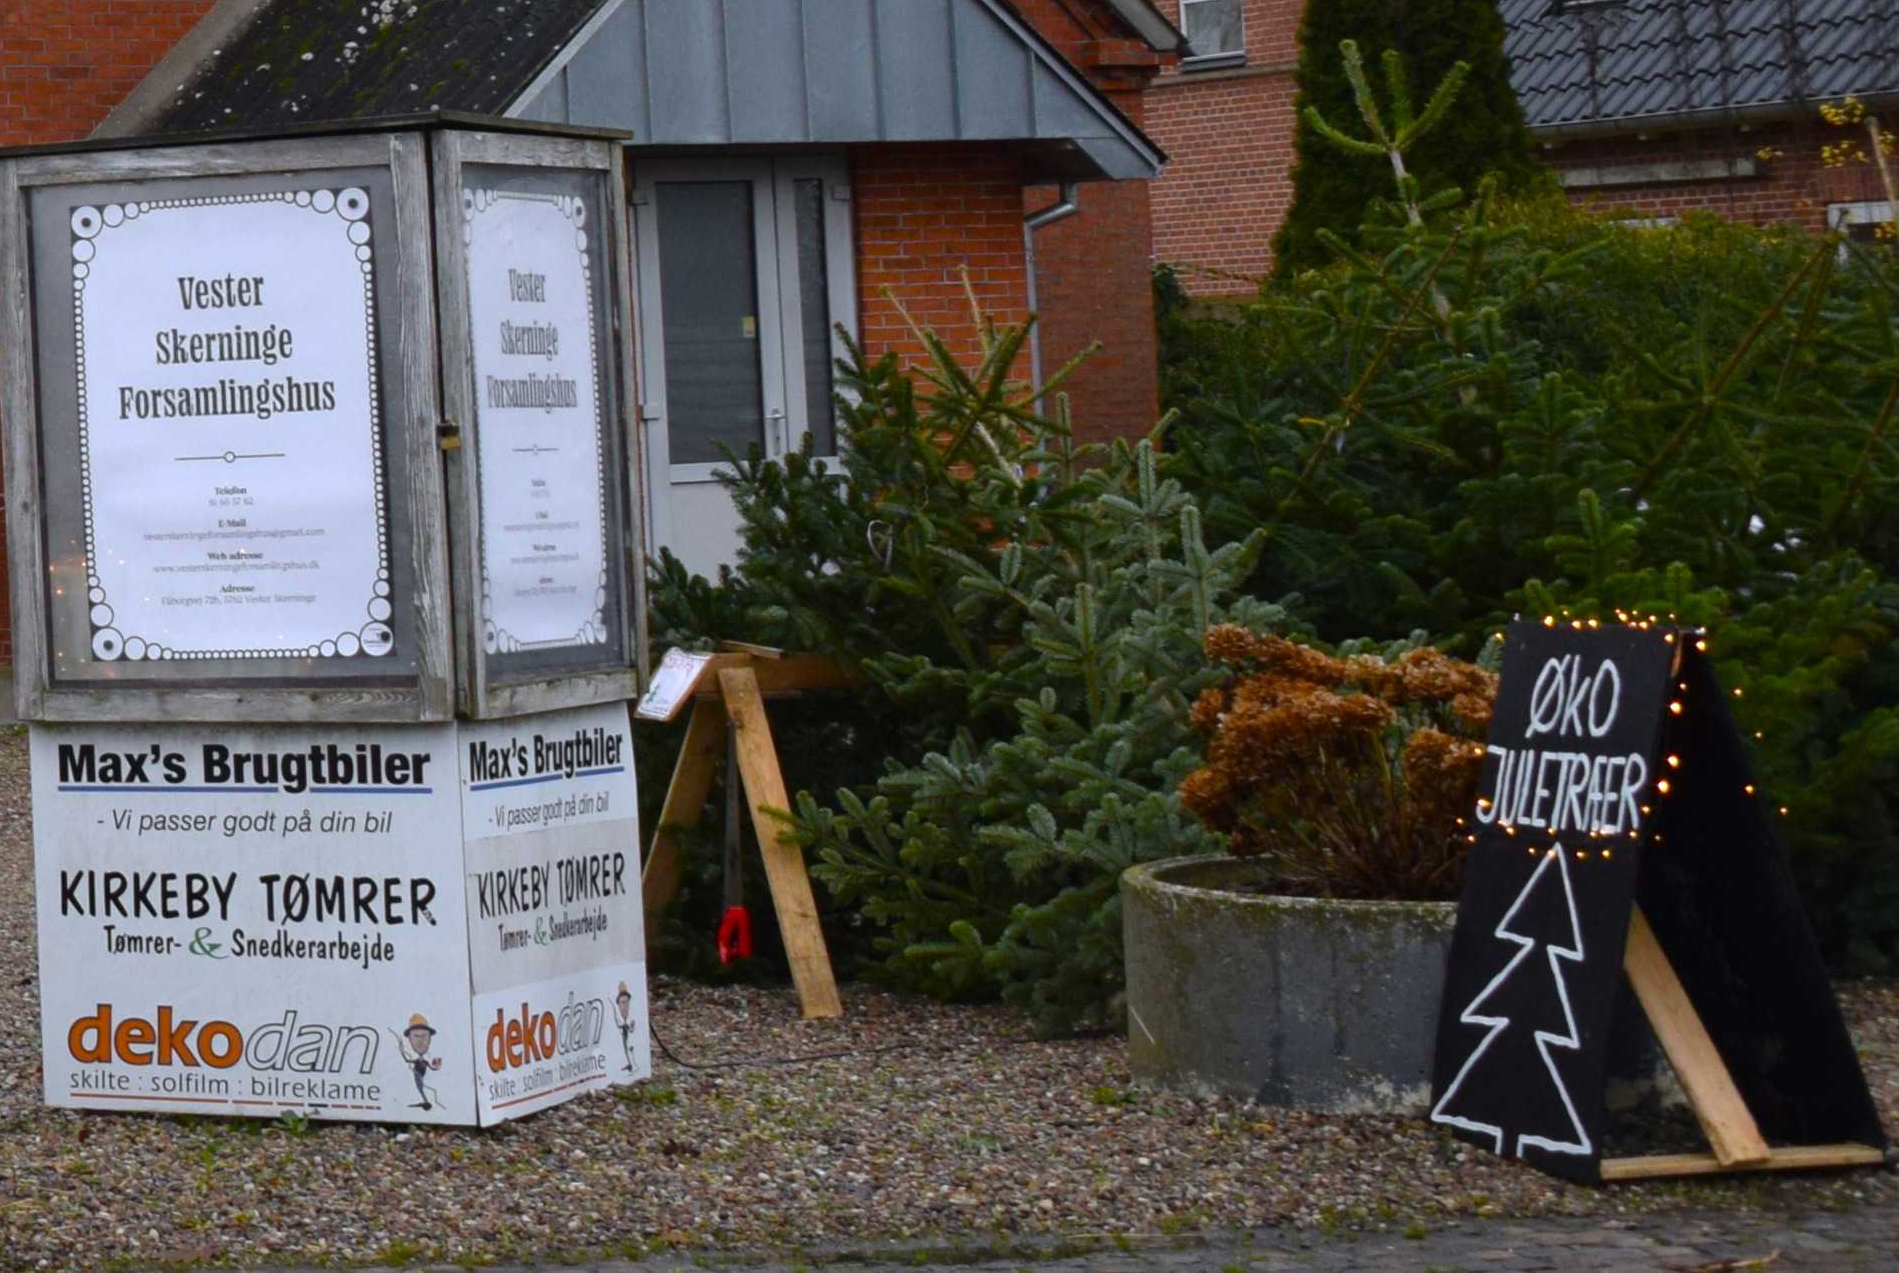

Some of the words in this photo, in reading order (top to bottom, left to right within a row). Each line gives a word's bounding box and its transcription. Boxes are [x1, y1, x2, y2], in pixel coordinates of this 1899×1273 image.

[178, 273, 264, 310] Vester
[508, 268, 546, 303] Vester
[156, 324, 293, 365] Skerninge
[500, 319, 559, 361] Skerninge
[118, 376, 336, 419] Forsamlingshus
[486, 373, 578, 414] Forsamlingshus
[214, 487, 248, 495] Telefon
[58, 743, 187, 784] Max's
[202, 743, 431, 793] Brugtbiler
[469, 737, 529, 782] Max's
[533, 727, 623, 778] Brugtbiler
[113, 809, 132, 831] Vi
[138, 812, 216, 835] passer
[223, 811, 276, 837] godt
[282, 810, 312, 837] på
[320, 811, 356, 833] din
[364, 811, 393, 833] bil
[495, 805, 505, 827] Vi
[507, 804, 542, 831] passer
[542, 797, 563, 826] godt
[564, 794, 577, 824] på
[577, 792, 594, 815] din
[596, 790, 610, 814] bil
[60, 870, 237, 922] KIRKEBY
[260, 873, 437, 926] TØMRER
[477, 860, 550, 920] KIRKEBY
[557, 851, 626, 908] TØMRER
[103, 925, 182, 955] Tømrer-
[188, 927, 229, 960] &
[231, 930, 395, 970] Snedkerarbejde
[498, 923, 532, 952] Tømrer-
[533, 917, 549, 946] &
[549, 906, 608, 942] Snedkerarbejde
[67, 1003, 380, 1074] dekodan
[486, 991, 605, 1074] dekodan
[70, 1070, 130, 1091] skilte
[151, 1073, 229, 1095] solfilm
[251, 1076, 381, 1101] bilreklame
[489, 1077, 516, 1100] skilte
[559, 1054, 607, 1081] bilreklame
